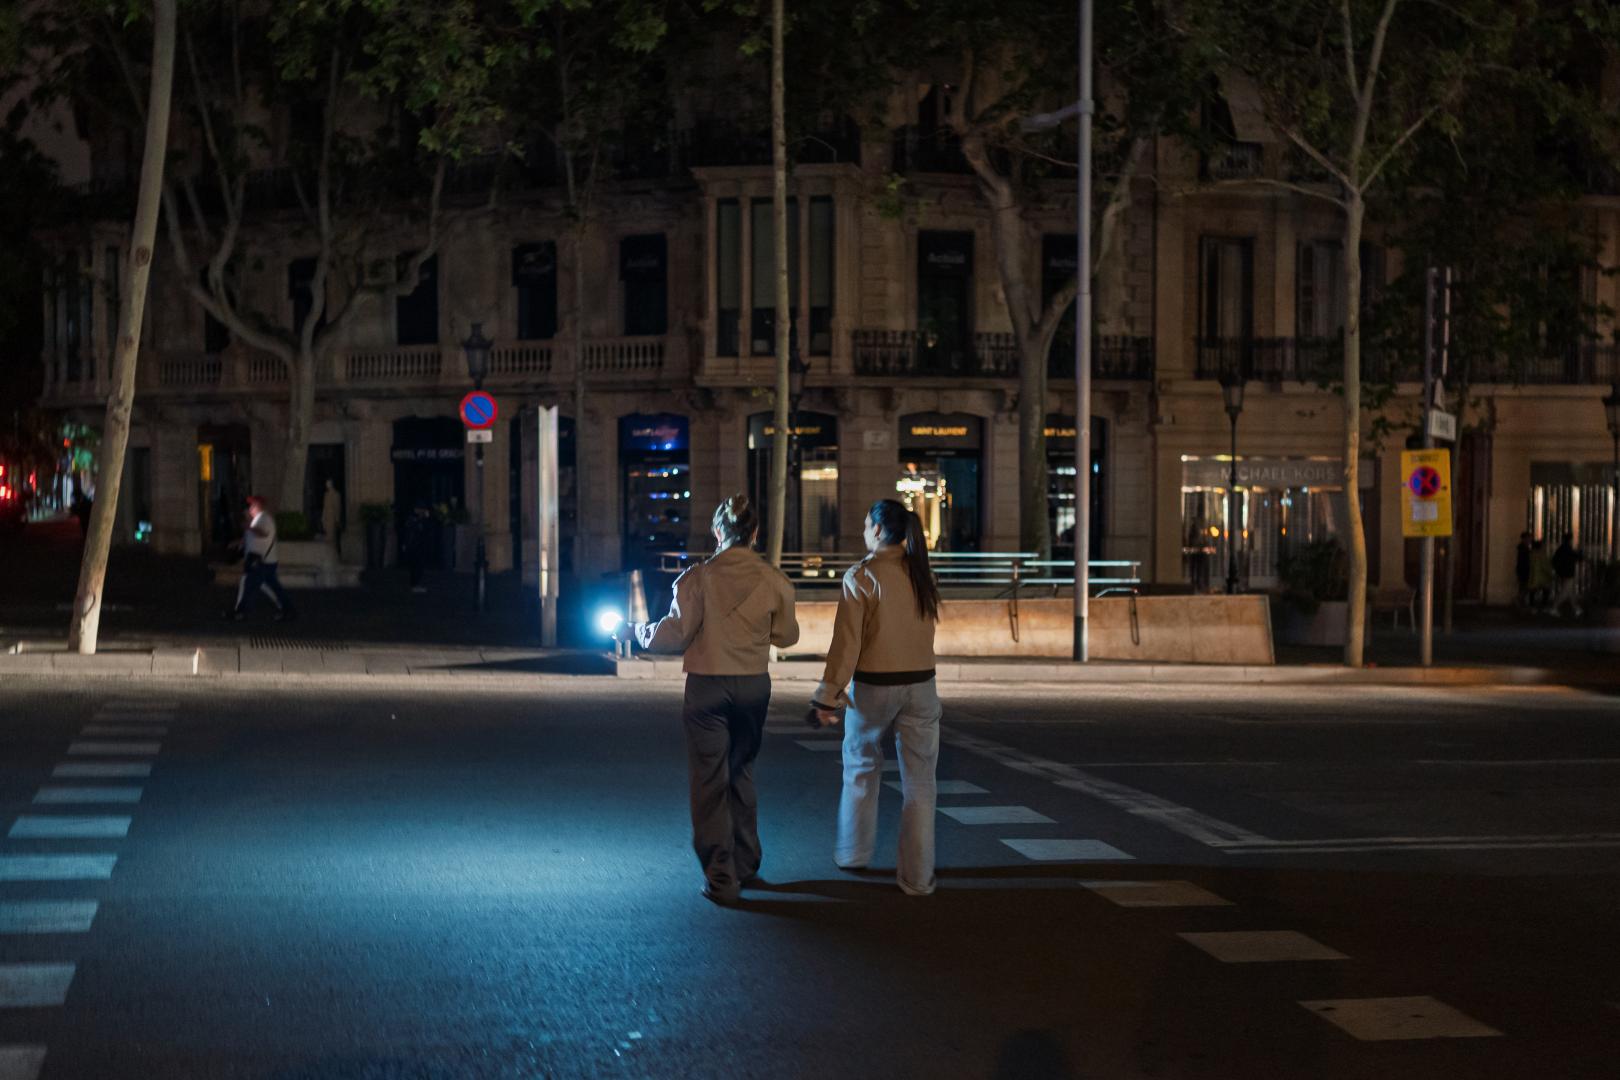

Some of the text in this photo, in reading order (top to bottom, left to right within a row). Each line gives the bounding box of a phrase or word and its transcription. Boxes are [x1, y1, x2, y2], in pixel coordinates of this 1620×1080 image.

[911, 425, 969, 436] SAINT LAURENT
[1220, 466, 1336, 481] MCHAEL KORS
